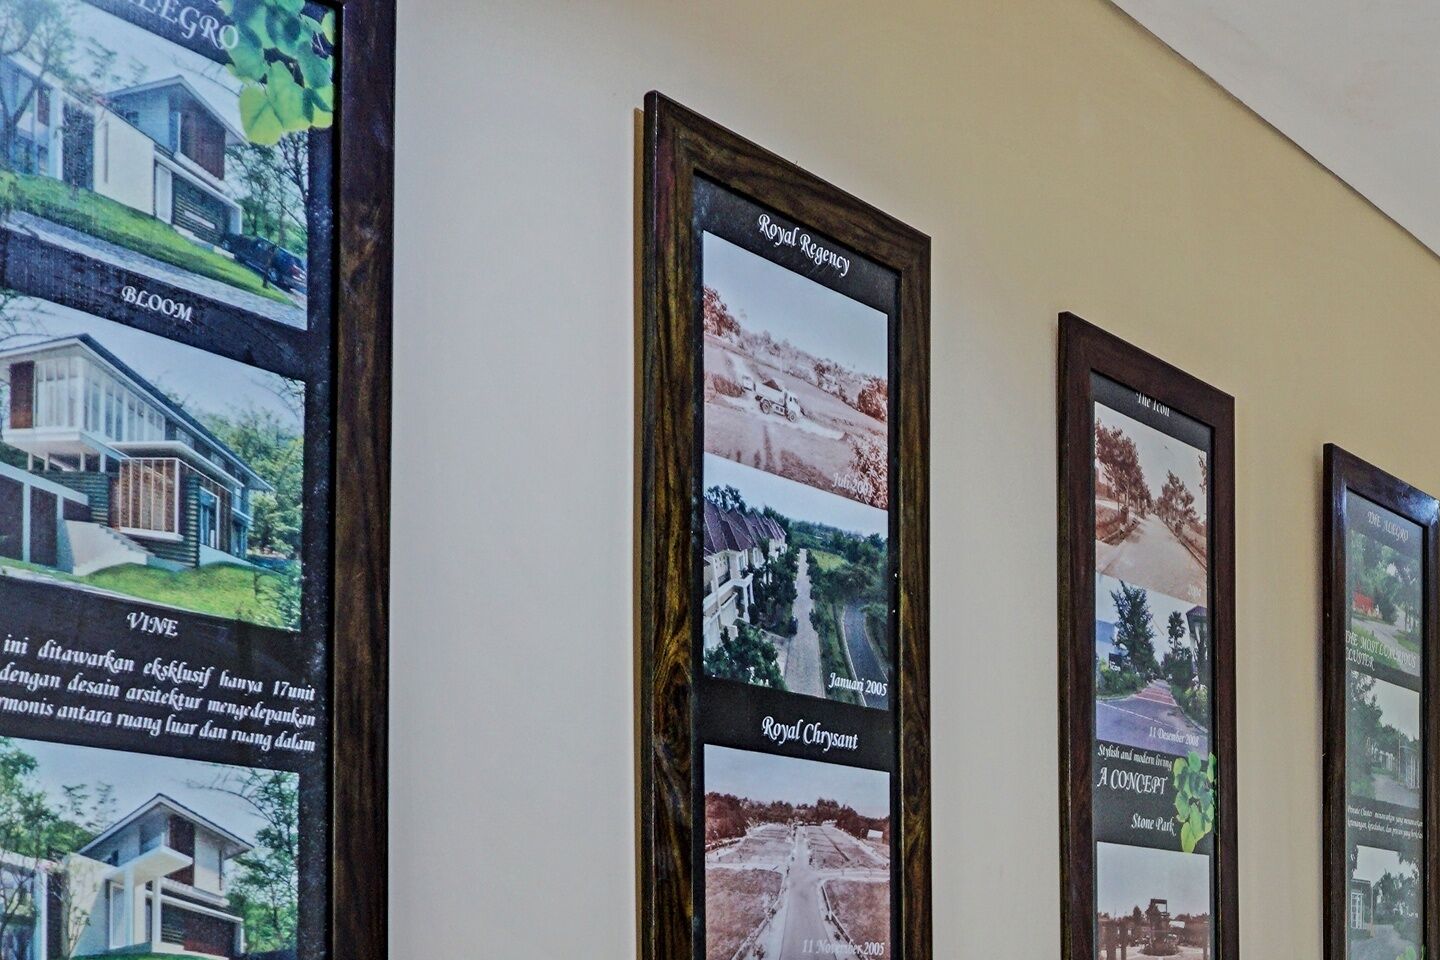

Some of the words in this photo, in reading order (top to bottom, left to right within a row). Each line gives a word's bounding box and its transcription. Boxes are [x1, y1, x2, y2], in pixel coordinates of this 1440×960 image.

[758, 214, 800, 247] Royal
[800, 234, 851, 278] Regency
[121, 285, 193, 325] BLOOM
[127, 611, 178, 637] VINE
[4, 633, 29, 656] ini
[38, 639, 135, 674] ditawarkan
[143, 657, 215, 690] eksklusif
[220, 669, 264, 696] hanya
[0, 661, 62, 692] dengan
[67, 672, 121, 698] desain
[126, 686, 204, 711] arsitektur
[207, 698, 316, 729] mengedepankan
[828, 672, 865, 693] Januari
[865, 679, 888, 697] 2005
[57, 705, 112, 725] antara
[116, 713, 163, 737] ruang
[165, 714, 199, 735] luar
[200, 719, 228, 741] dan
[231, 729, 273, 751] ruang
[274, 730, 316, 752] dalam
[762, 716, 803, 745] Royal
[803, 722, 859, 753] Chrysant
[1097, 766, 1109, 787] A
[1110, 768, 1169, 795] CONCEPT
[1131, 812, 1155, 830] Stone
[1155, 816, 1177, 837] Park
[801, 939, 814, 954] 11
[864, 942, 886, 956] 2005
